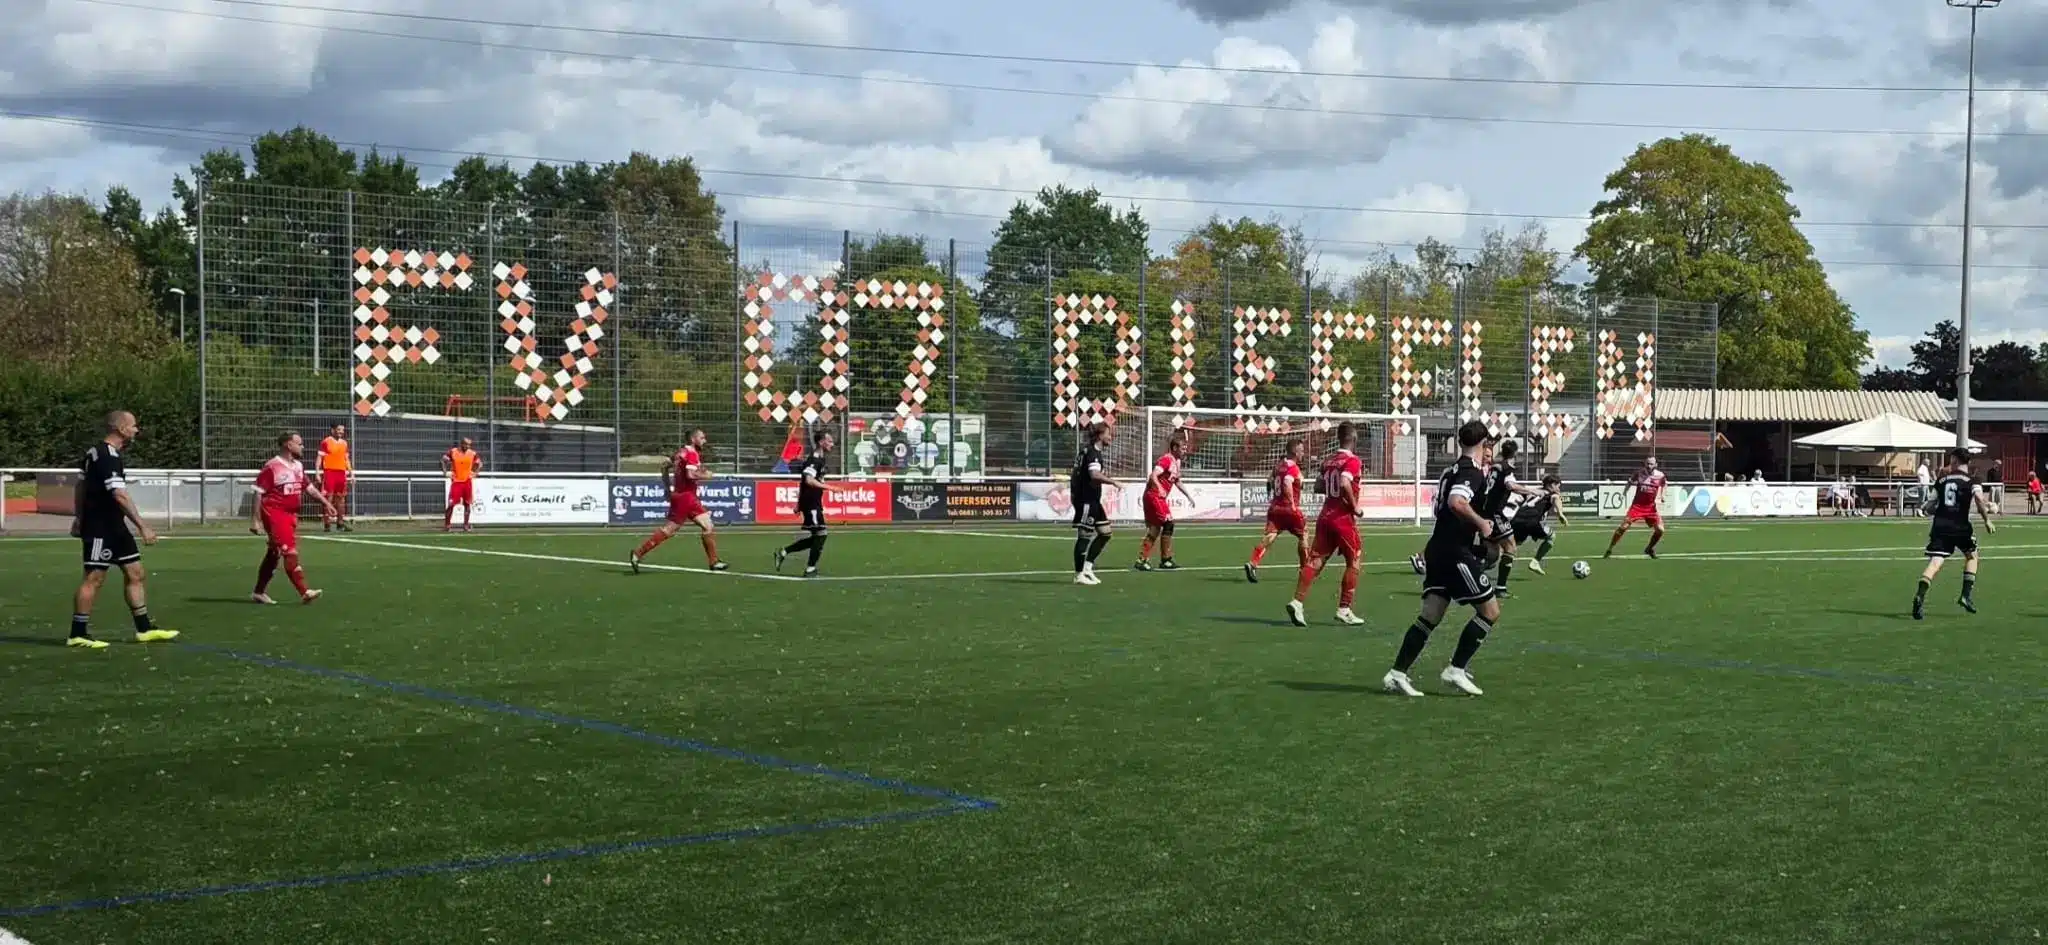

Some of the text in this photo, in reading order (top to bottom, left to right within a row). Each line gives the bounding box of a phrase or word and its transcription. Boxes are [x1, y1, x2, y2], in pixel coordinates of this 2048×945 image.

[353, 246, 618, 422] FV
[744, 270, 945, 431] 07
[612, 485, 632, 497] GS
[635, 485, 665, 497] Fleis
[732, 486, 752, 497] UG
[776, 487, 800, 502] RE
[1944, 482, 1959, 506] 6
[492, 494, 566, 504] Kai Schmitt
[946, 496, 1011, 505] LIEFERSERVICE
